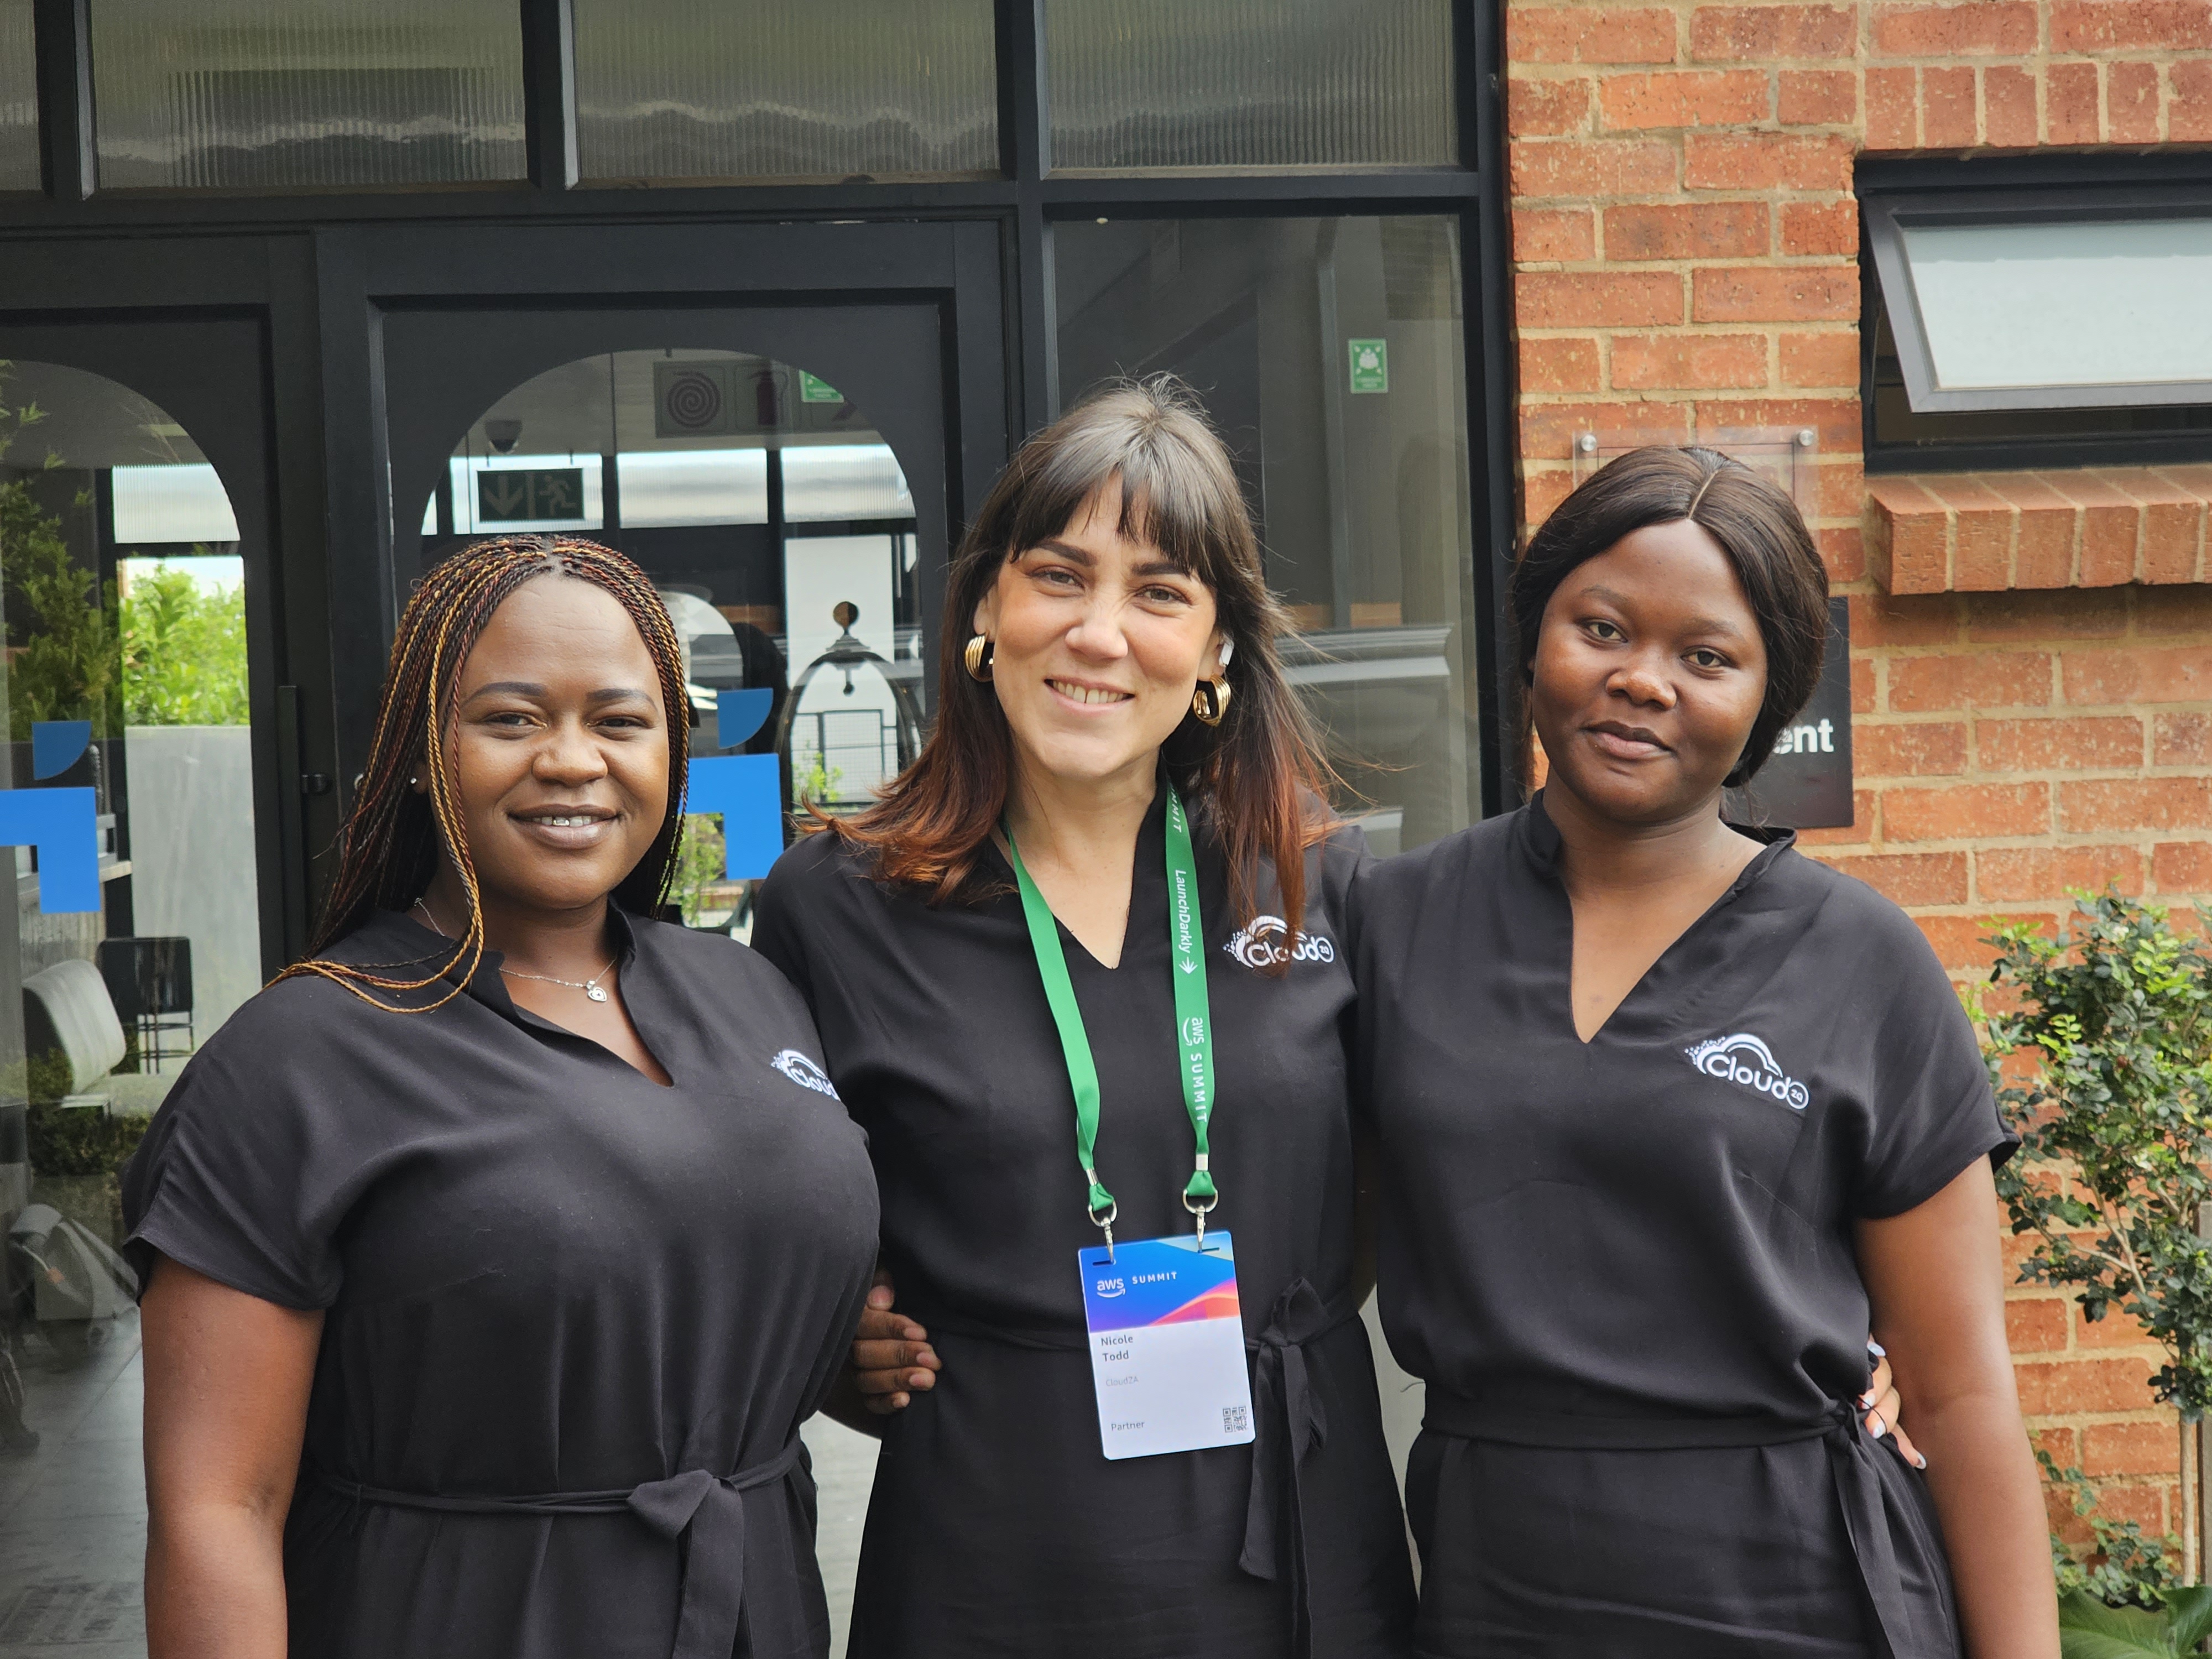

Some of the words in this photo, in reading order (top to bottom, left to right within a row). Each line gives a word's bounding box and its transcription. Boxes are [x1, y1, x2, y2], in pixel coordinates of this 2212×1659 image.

[1175, 869, 1193, 954] LaunchDarkly
[1191, 1017, 1204, 1045] aws
[1706, 1054, 1791, 1099] Cloud
[1191, 1053, 1207, 1122] SUMMIT
[1097, 1277, 1125, 1291] aws
[1132, 1271, 1177, 1285] SUMMIT
[1100, 1334, 1134, 1346] Nicole
[1102, 1350, 1129, 1362] Todd
[1105, 1376, 1139, 1387] CloudZA
[1110, 1421, 1145, 1431] Partner
